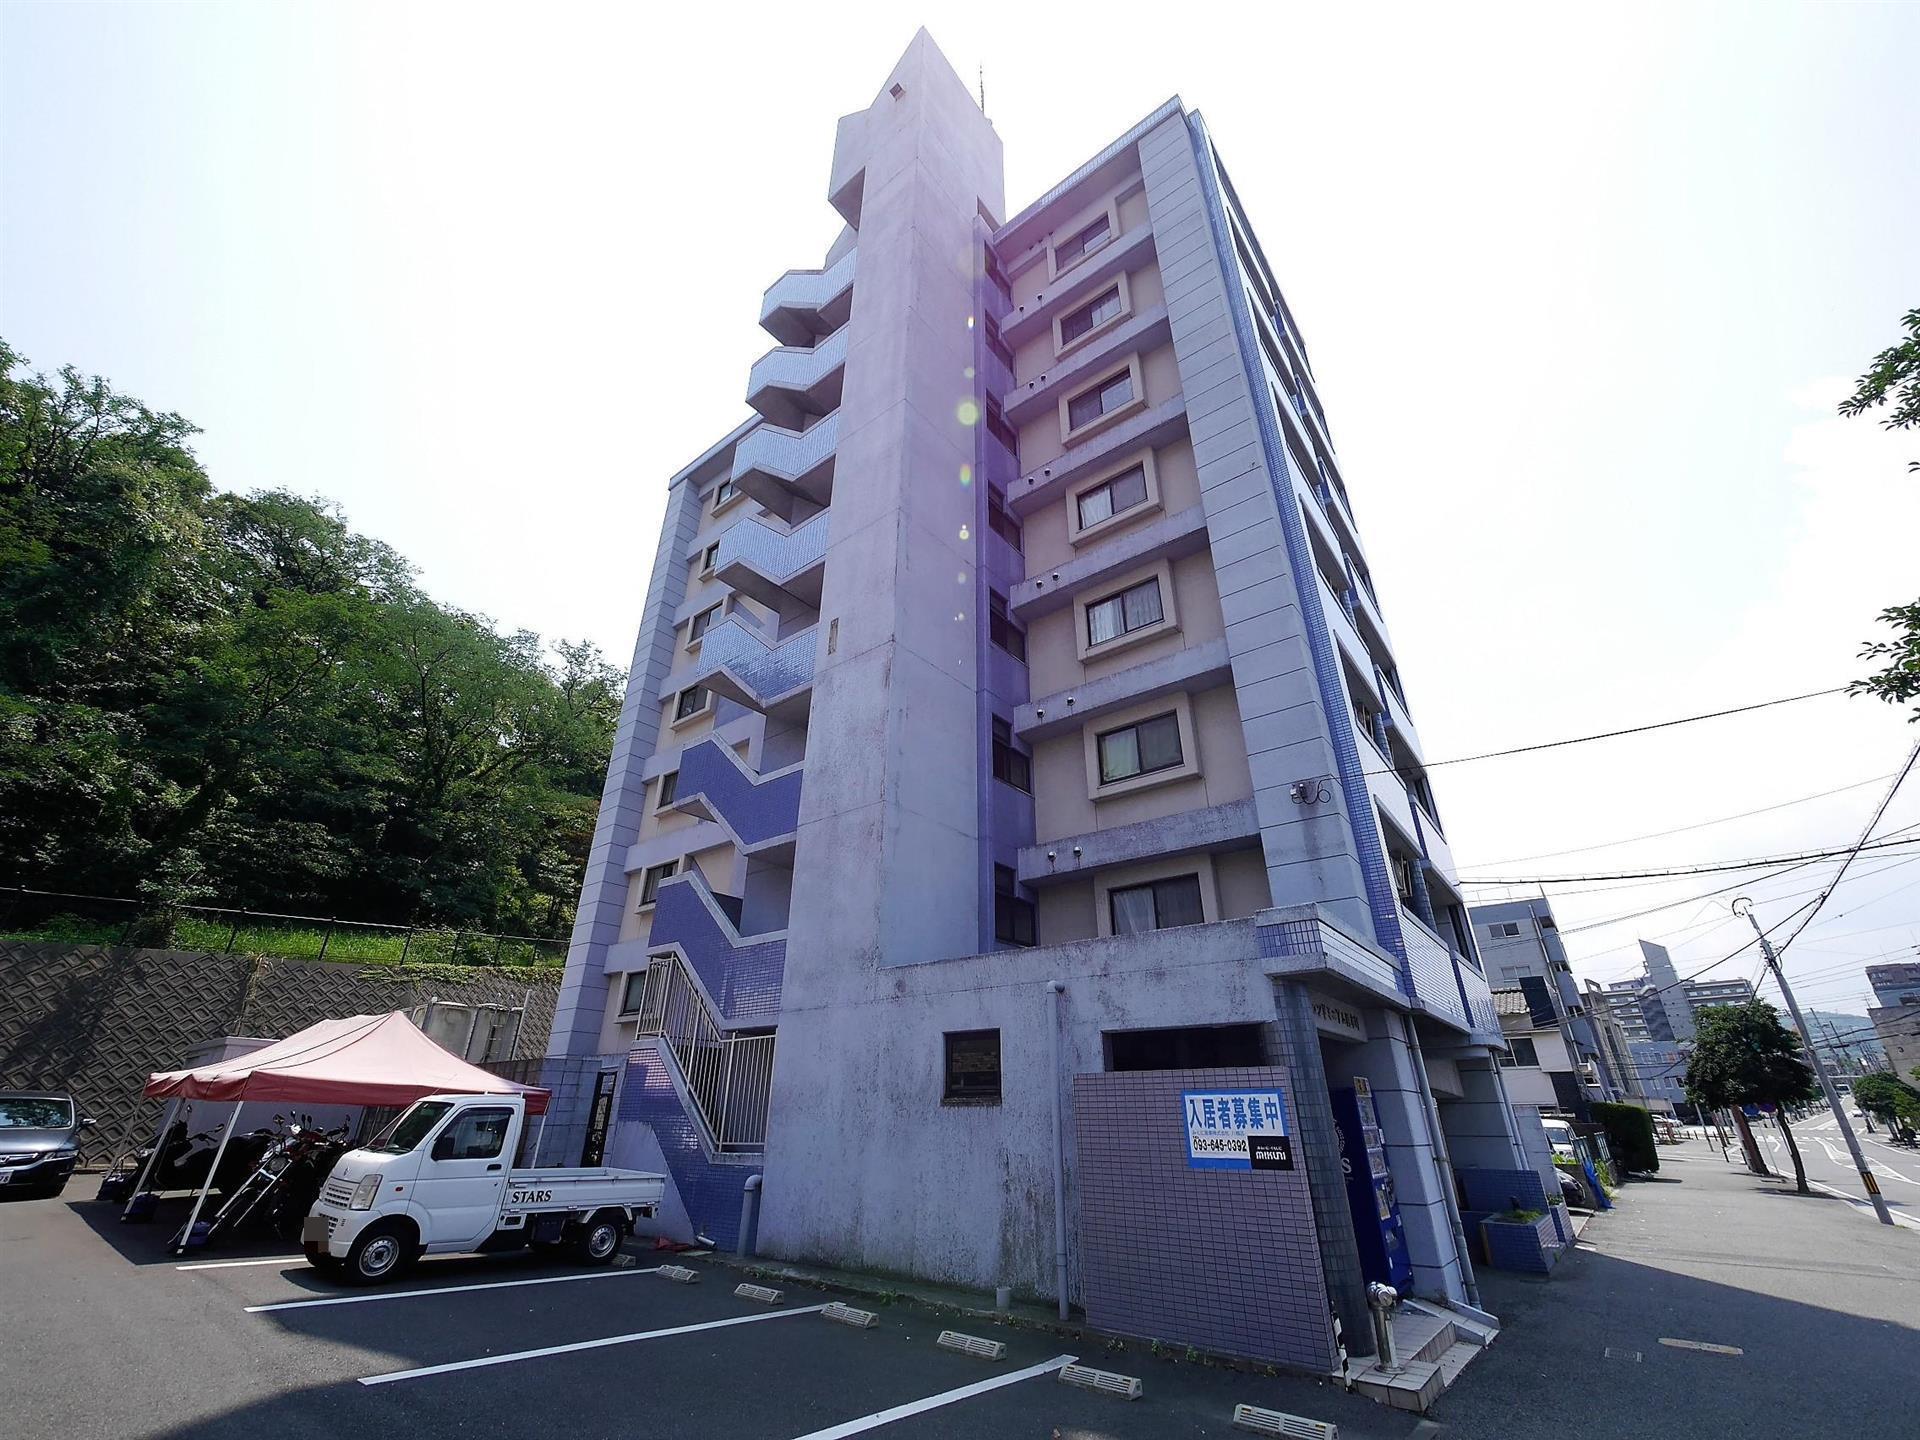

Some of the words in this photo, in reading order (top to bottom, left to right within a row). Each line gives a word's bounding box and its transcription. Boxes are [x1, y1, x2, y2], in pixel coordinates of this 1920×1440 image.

[1189, 1096, 1279, 1130] 入居者募集中
[1193, 1139, 1248, 1152] 093-645-0392
[511, 1189, 553, 1203] STARS
